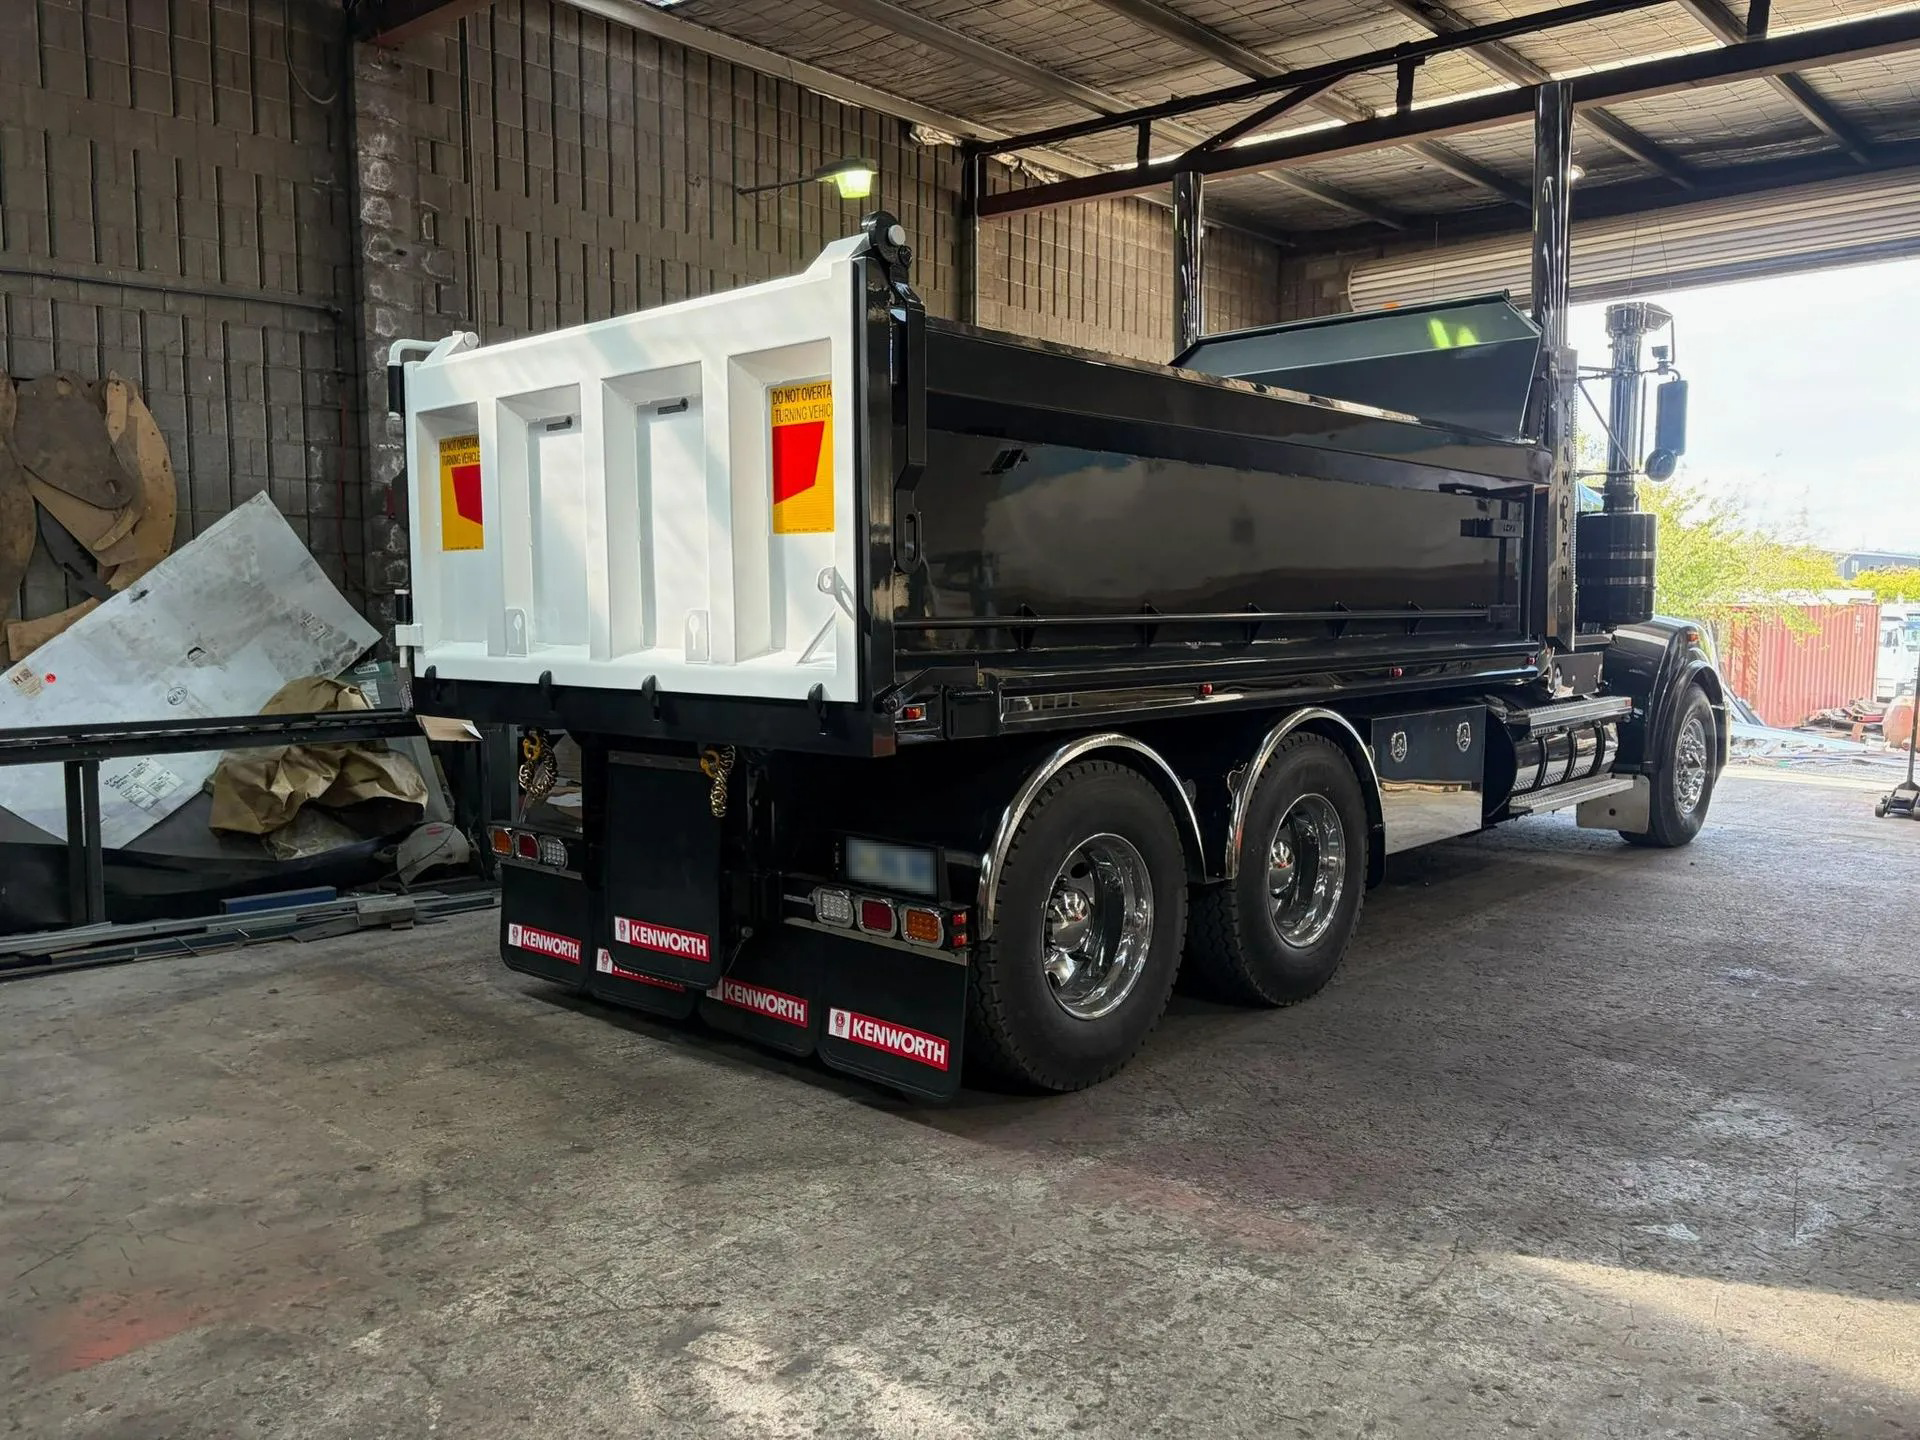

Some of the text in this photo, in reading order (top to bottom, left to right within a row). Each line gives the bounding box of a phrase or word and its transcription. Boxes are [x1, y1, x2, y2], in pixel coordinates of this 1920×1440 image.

[773, 384, 832, 405] DO NOT OVERTA
[775, 402, 832, 423] TURNING VEHIC
[1561, 399, 1571, 580] KENWORTH
[522, 929, 580, 961] KENWORTH
[631, 924, 707, 958] KENWORTH
[724, 981, 805, 1023] KENWORTH
[852, 1018, 945, 1065] KENWORTH
